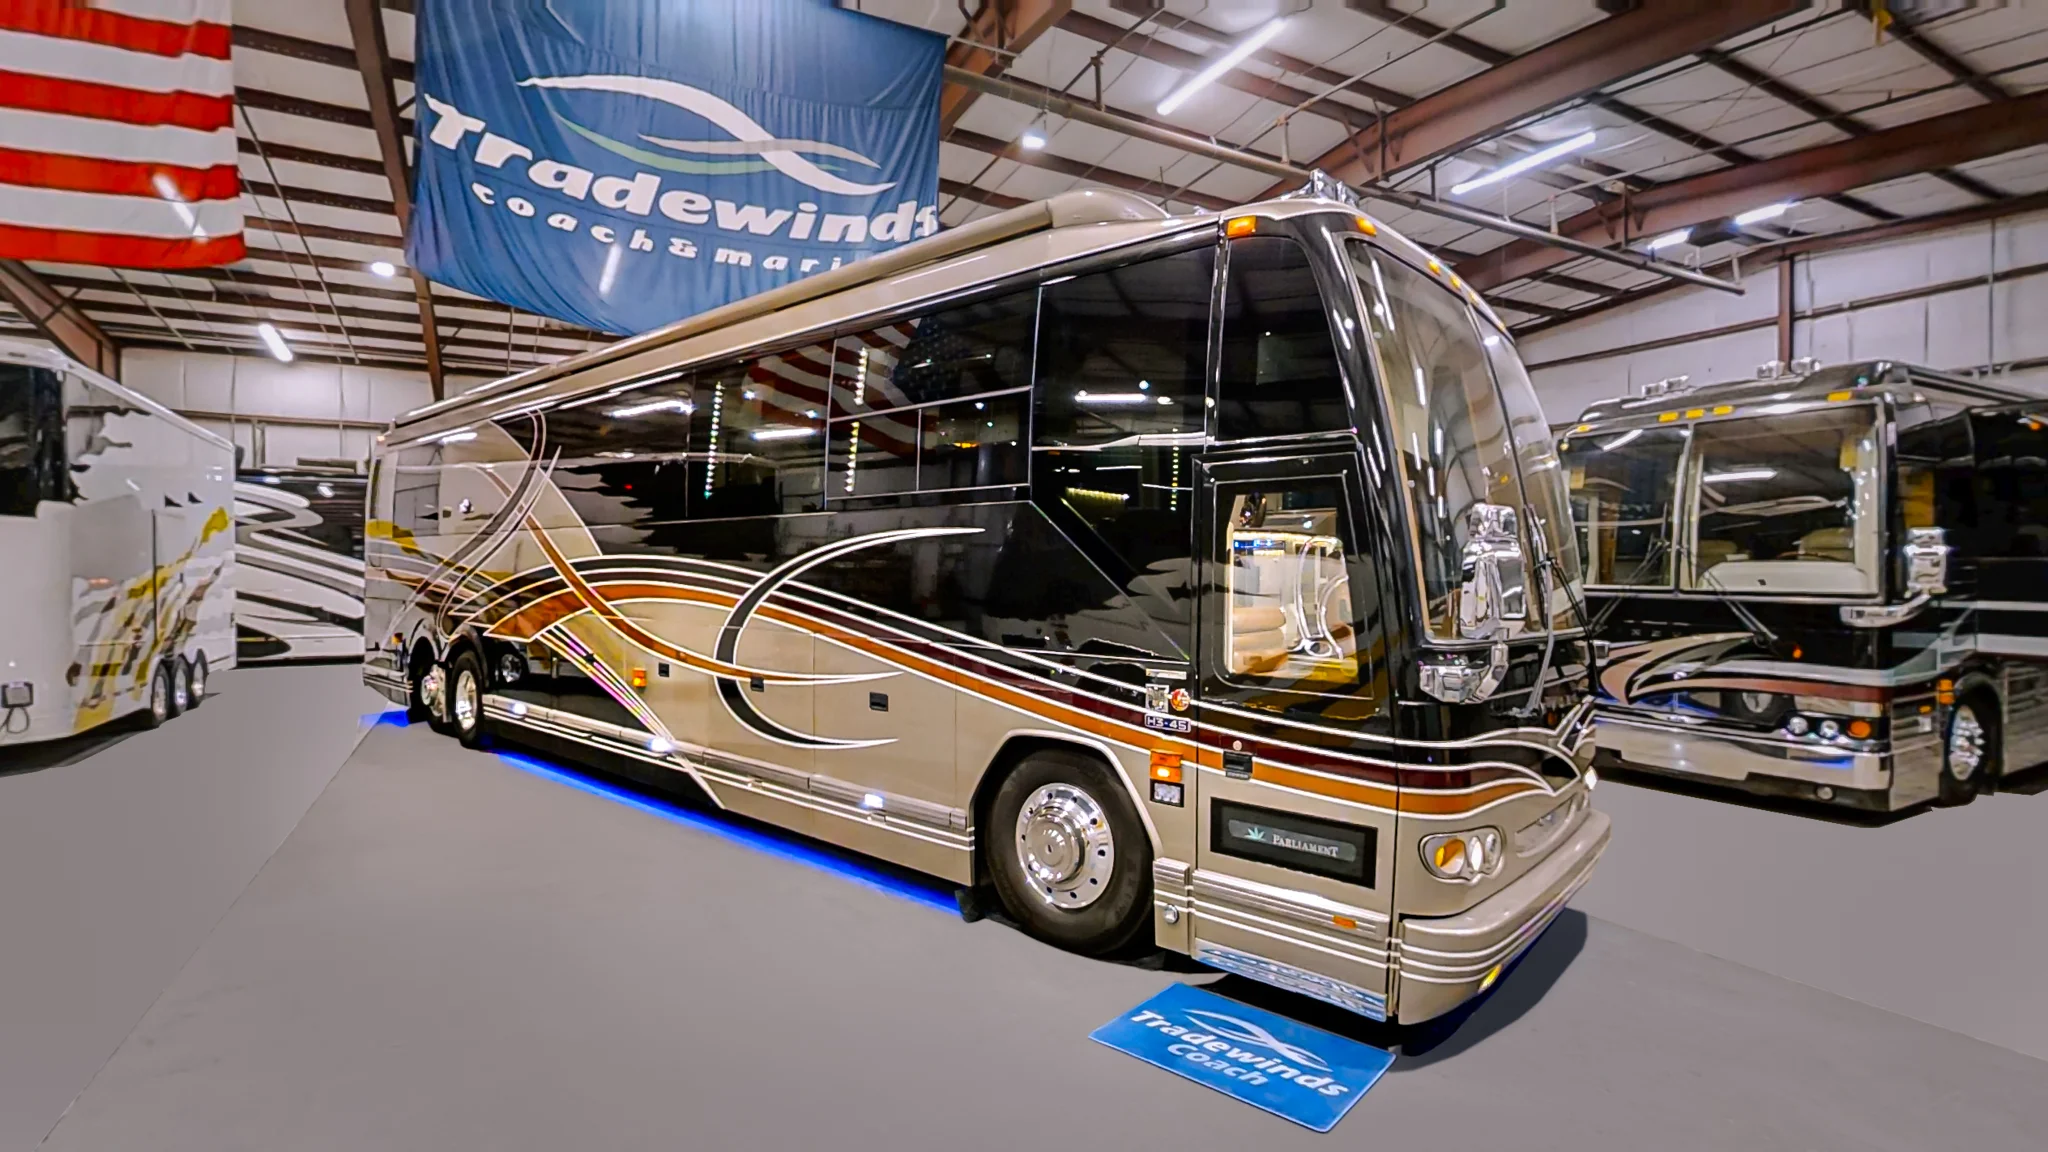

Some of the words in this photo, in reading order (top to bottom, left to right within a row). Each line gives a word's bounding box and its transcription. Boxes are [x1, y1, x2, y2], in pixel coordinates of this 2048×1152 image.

[424, 93, 939, 243] Tradewinds
[1147, 716, 1187, 731] H3-45
[1130, 1010, 1349, 1097] Tradewinds
[1167, 1043, 1269, 1086] Coach
